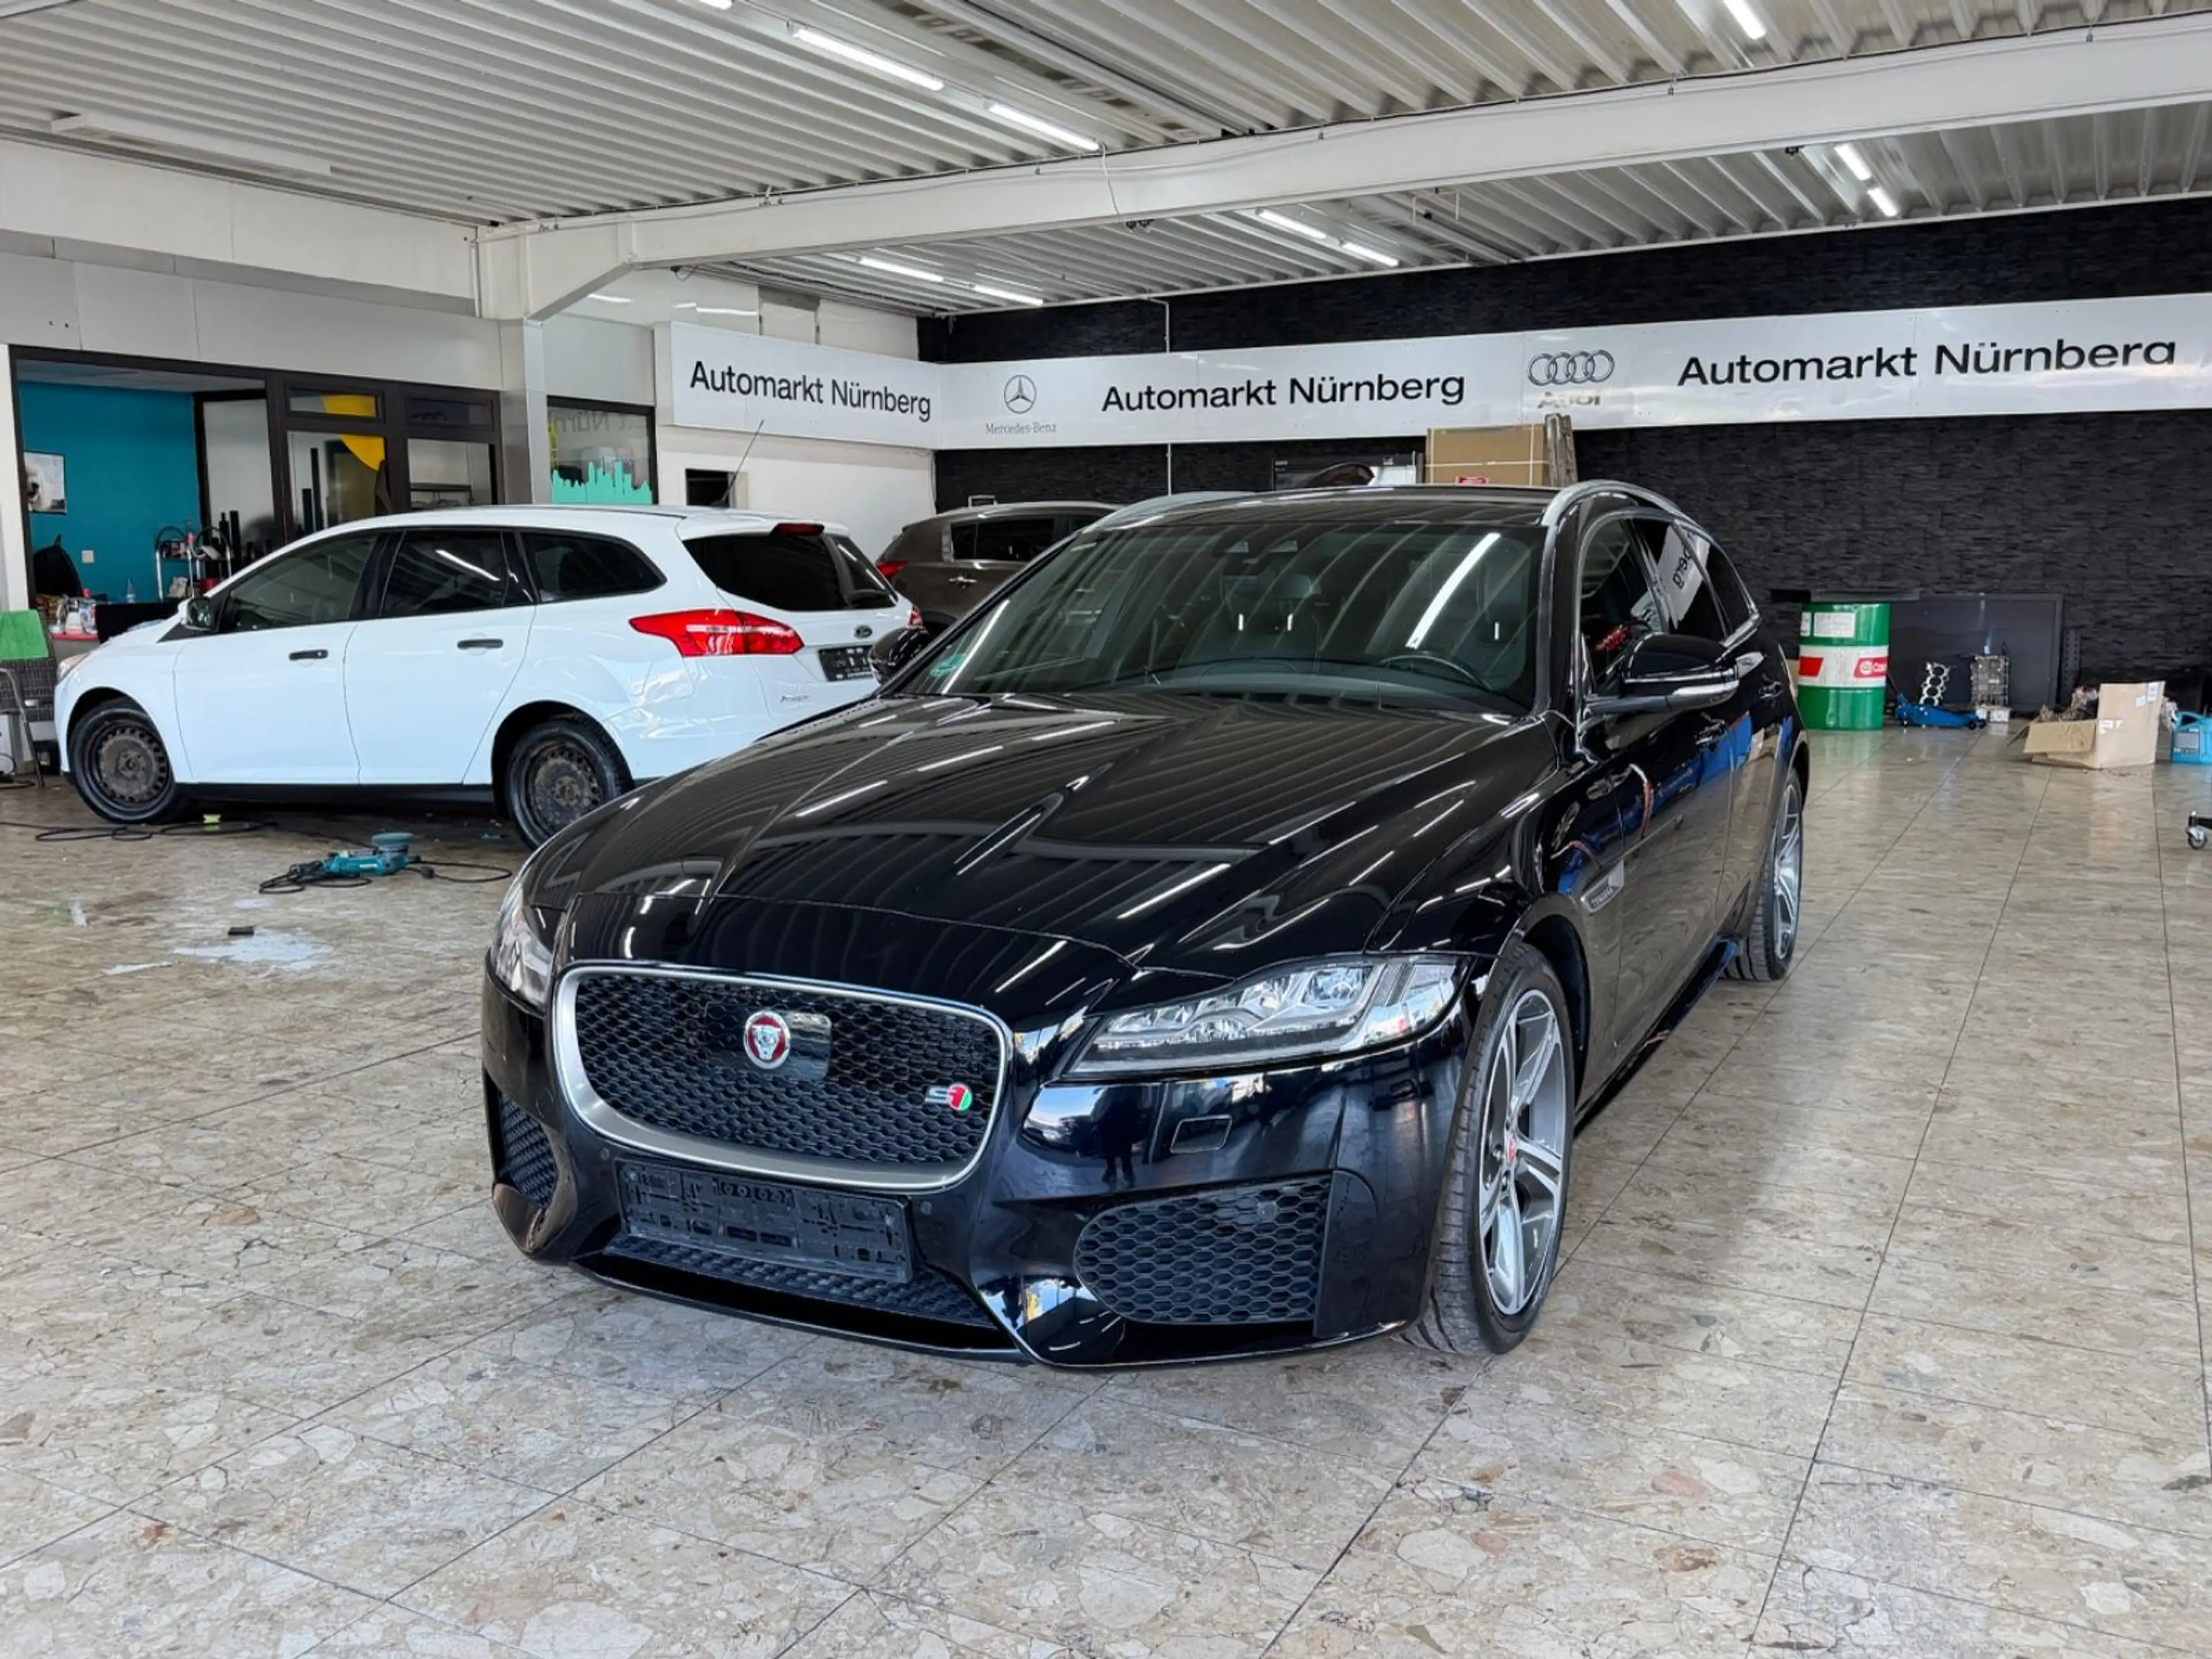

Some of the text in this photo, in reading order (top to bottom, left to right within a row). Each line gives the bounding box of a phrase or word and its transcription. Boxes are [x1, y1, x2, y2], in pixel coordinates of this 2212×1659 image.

[1677, 338, 2176, 387] Automarkt Nürnberg
[690, 361, 931, 423] Automarkt Nürnberg
[1101, 373, 1465, 412] Automarkt Nürnberg
[985, 421, 1058, 435] Mercedes-Benz
